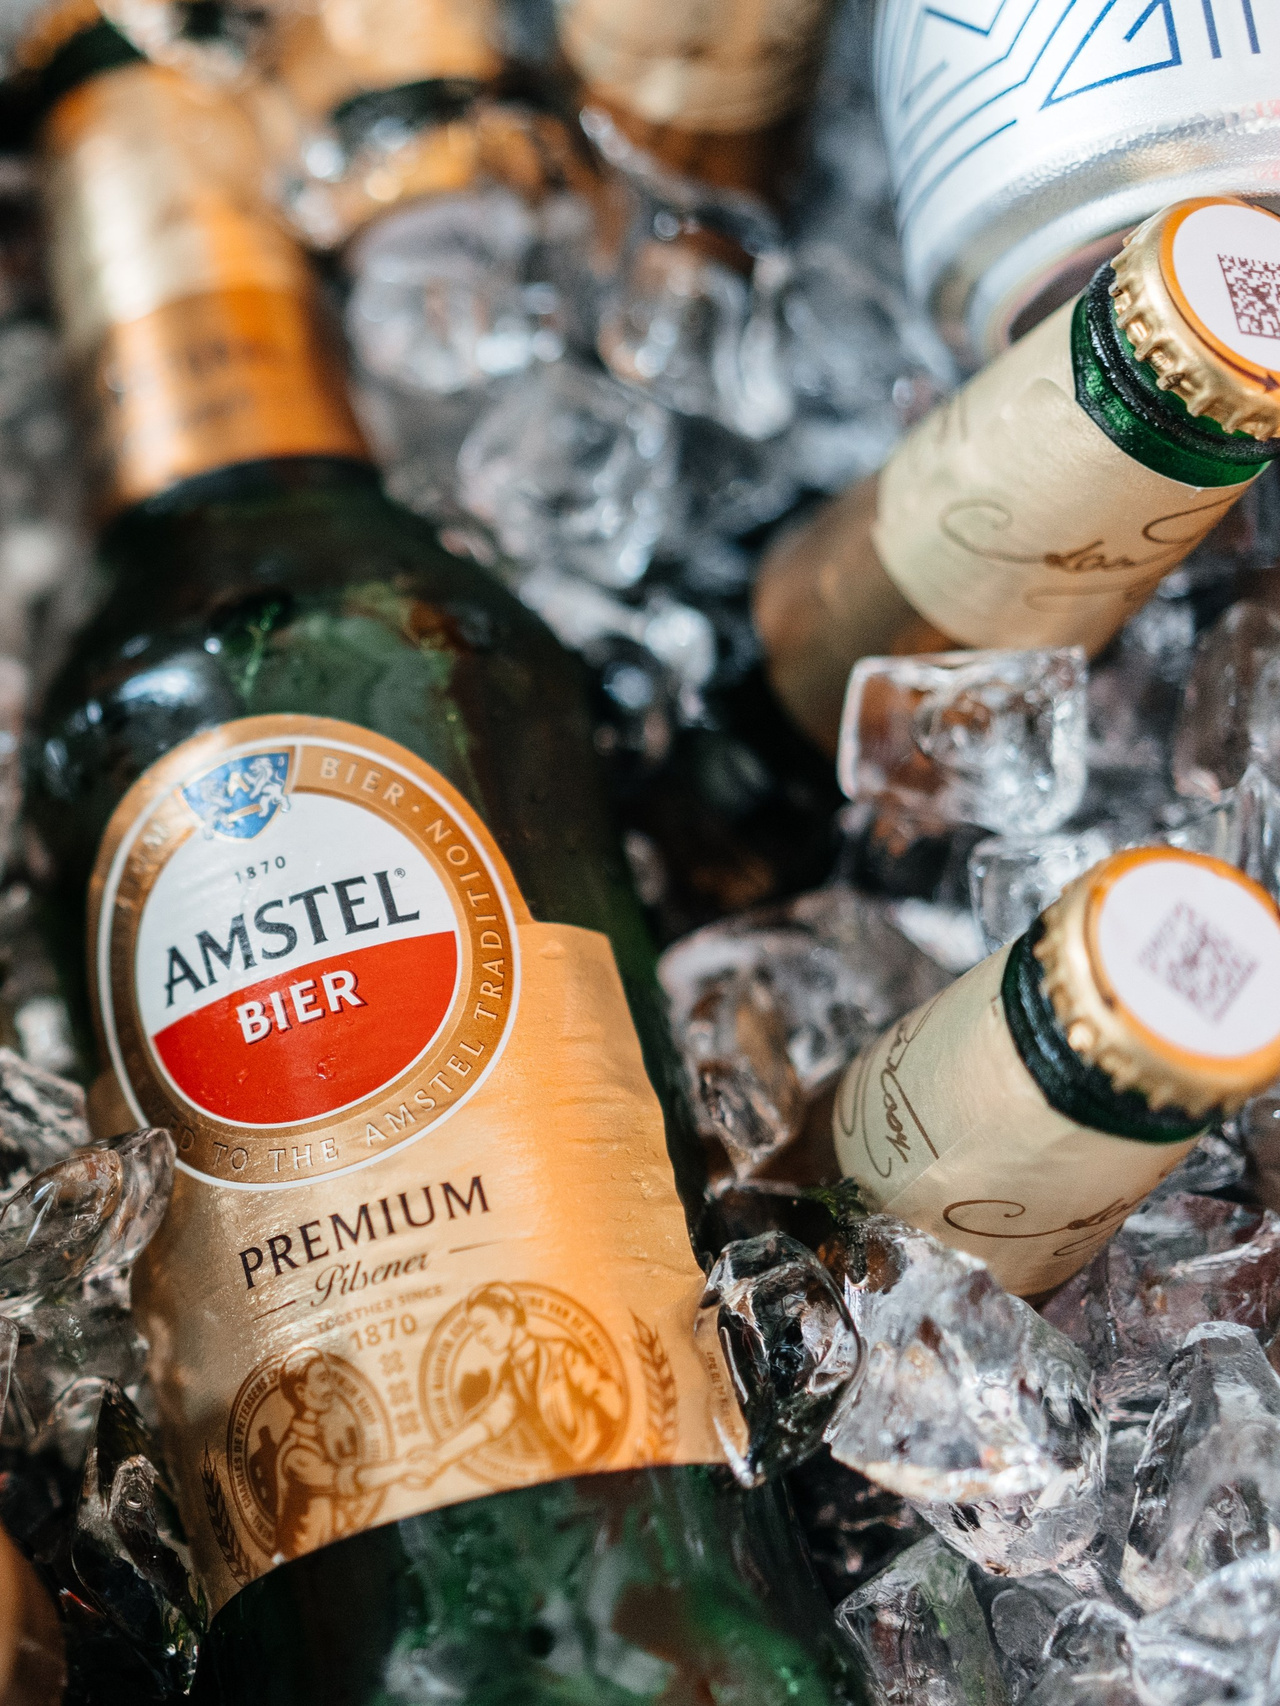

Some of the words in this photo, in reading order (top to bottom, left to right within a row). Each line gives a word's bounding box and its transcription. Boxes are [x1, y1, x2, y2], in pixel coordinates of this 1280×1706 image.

[320, 755, 406, 802] BIER
[234, 856, 287, 884] 1870
[164, 869, 421, 1008] AMSTEL
[424, 818, 508, 1024] TRADITION
[235, 969, 369, 1045] BIER
[364, 1038, 486, 1148] AMSTEL
[212, 1141, 250, 1171] TO
[269, 1137, 340, 1174] THE
[237, 1175, 491, 1290] PREMIUM
[310, 1252, 430, 1308] Pilsener
[349, 1312, 418, 1351] 1870
